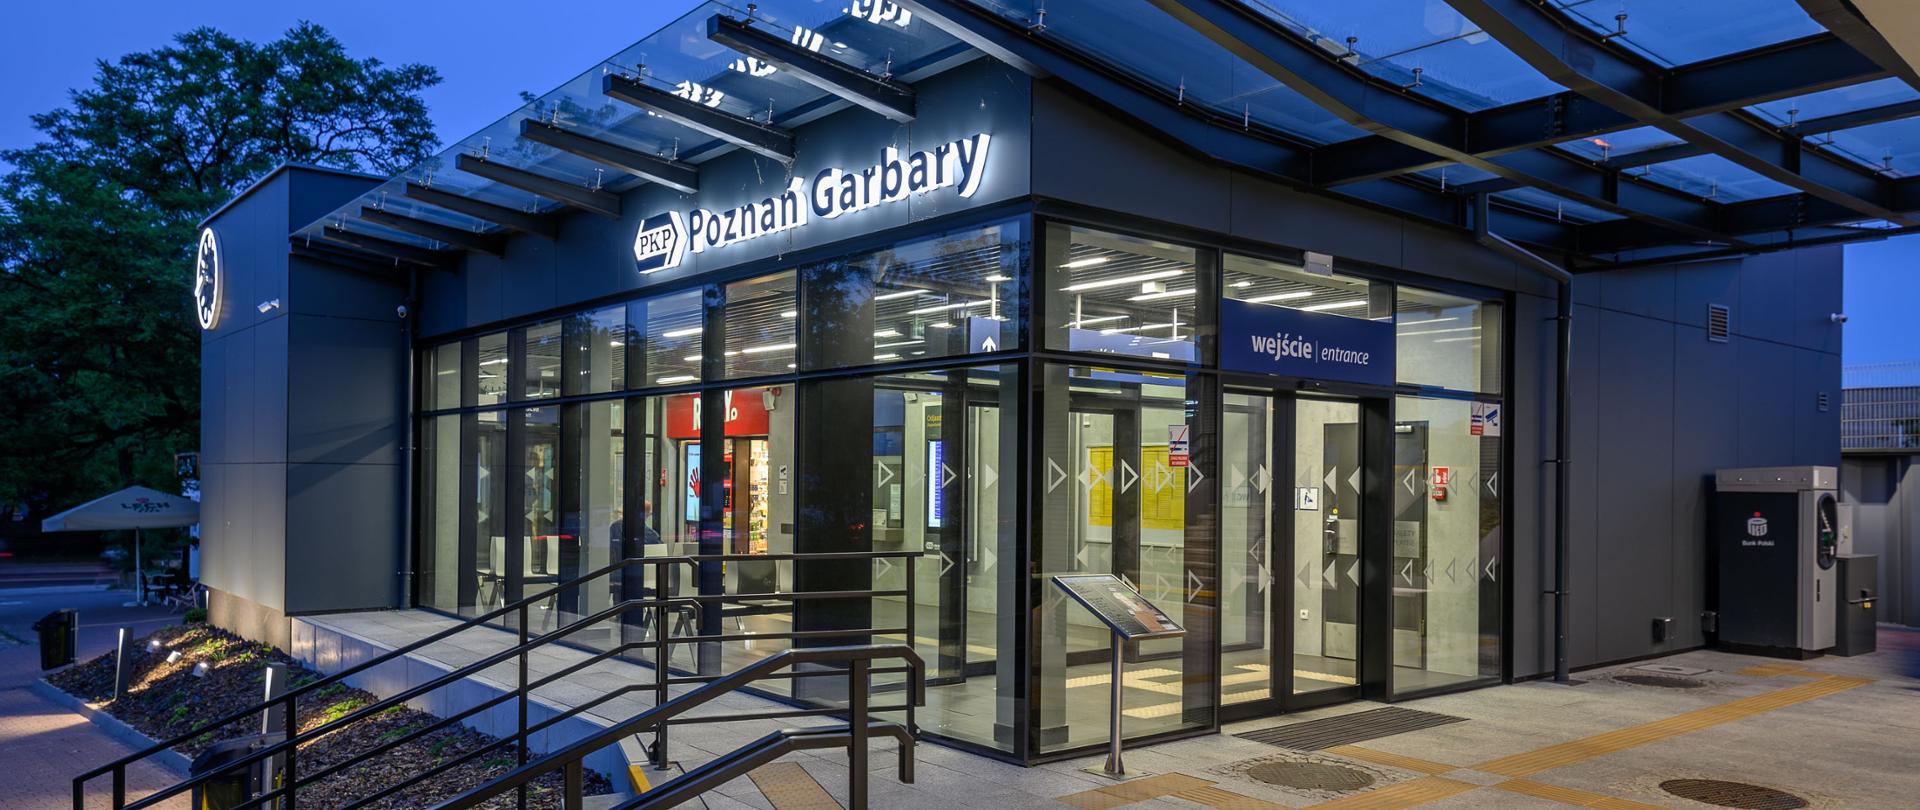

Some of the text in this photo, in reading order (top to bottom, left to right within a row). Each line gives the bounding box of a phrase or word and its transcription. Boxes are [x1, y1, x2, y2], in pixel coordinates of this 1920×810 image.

[640, 133, 991, 256] PKP Poznań Garbary
[1251, 332, 1369, 365] wejście entrance
